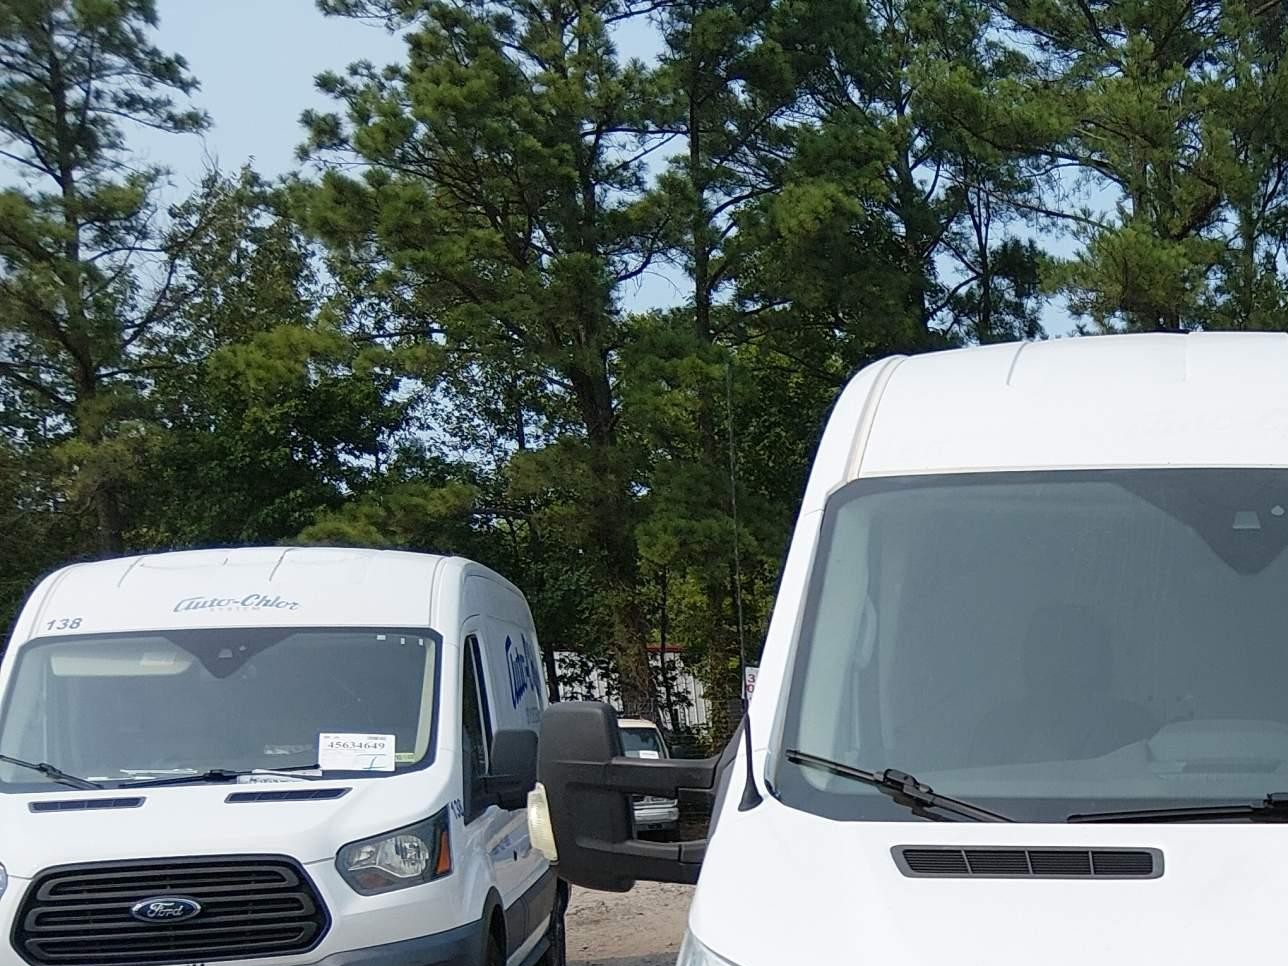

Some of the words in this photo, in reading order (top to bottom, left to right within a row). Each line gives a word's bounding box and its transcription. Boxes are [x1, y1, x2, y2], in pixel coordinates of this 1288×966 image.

[173, 594, 300, 613] Auto-Chlor
[47, 617, 82, 631] 138
[328, 741, 385, 750] 45634649
[147, 902, 184, 917] Ford
